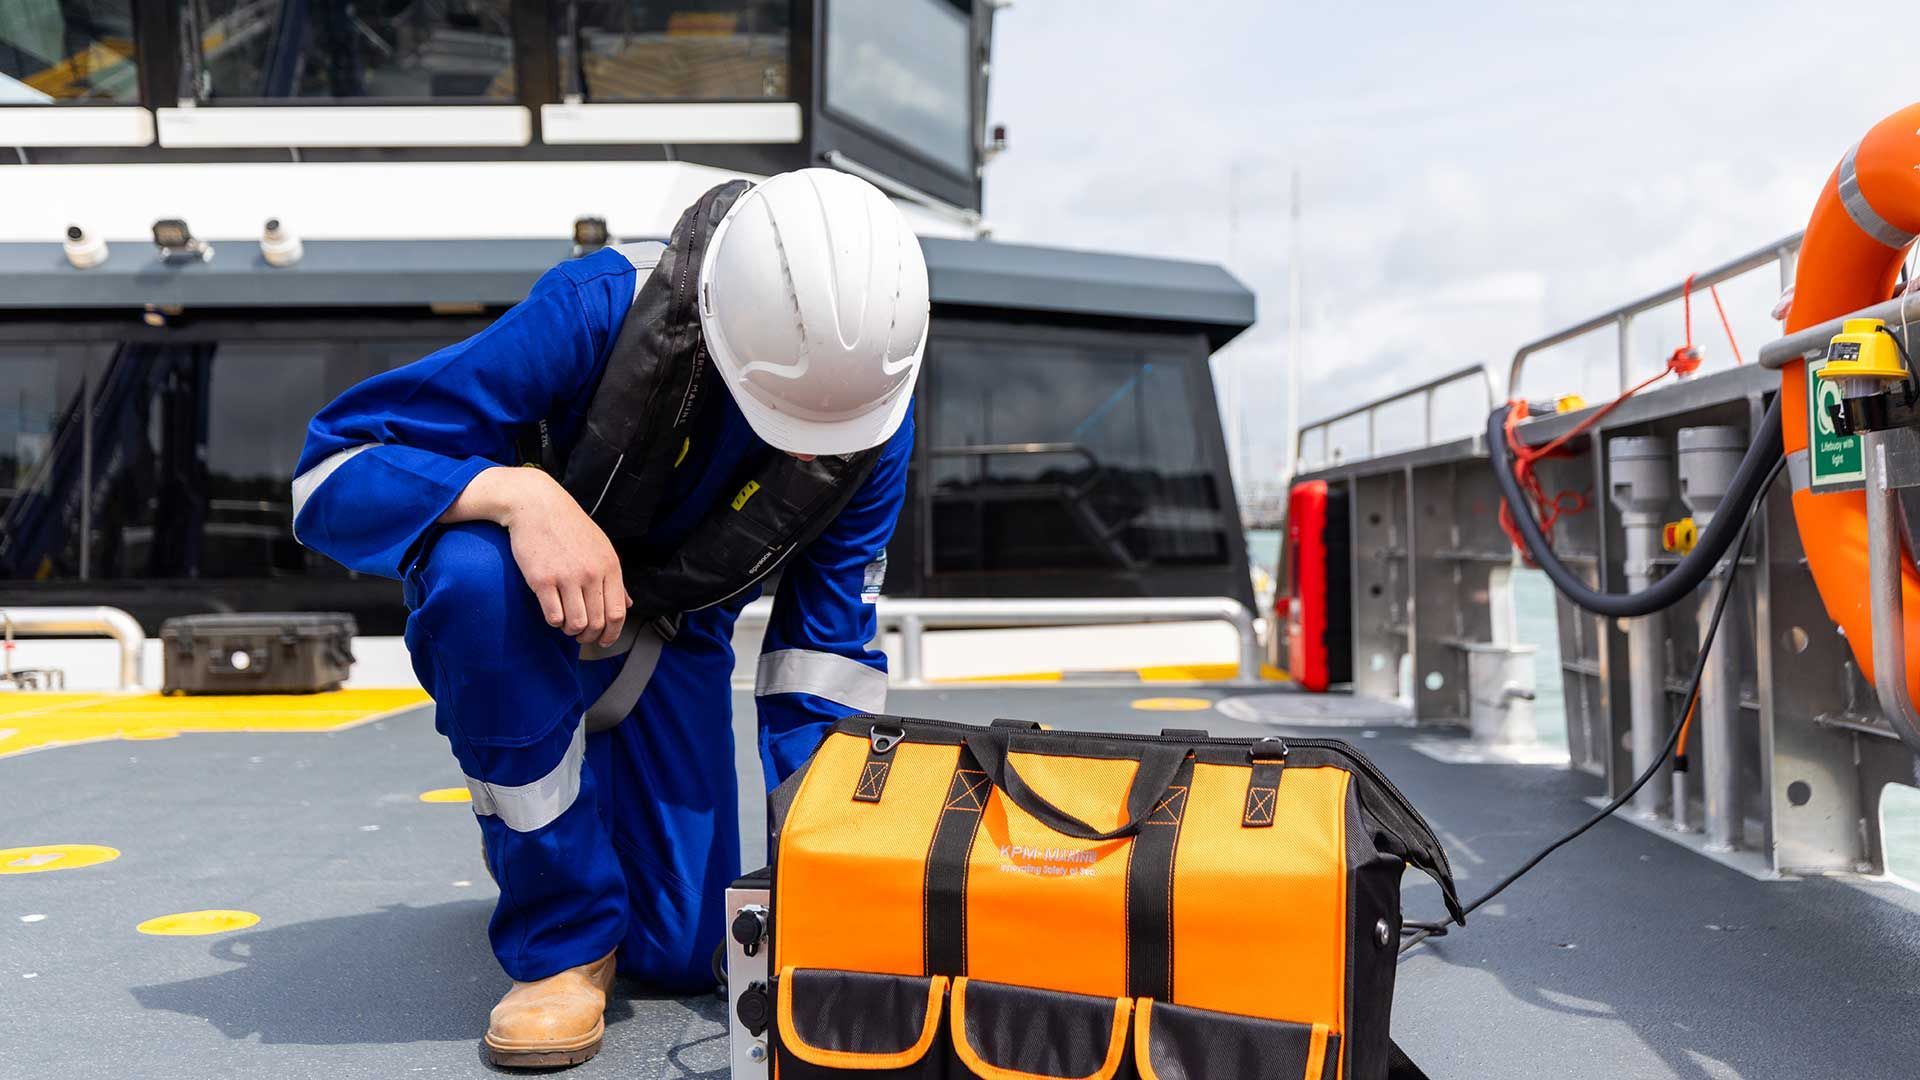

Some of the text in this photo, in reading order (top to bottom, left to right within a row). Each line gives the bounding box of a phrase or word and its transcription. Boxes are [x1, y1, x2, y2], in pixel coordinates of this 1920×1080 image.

[696, 341, 706, 379] VERSE
[1820, 438, 1855, 453] Lifebuoy with
[1832, 453, 1844, 467] light
